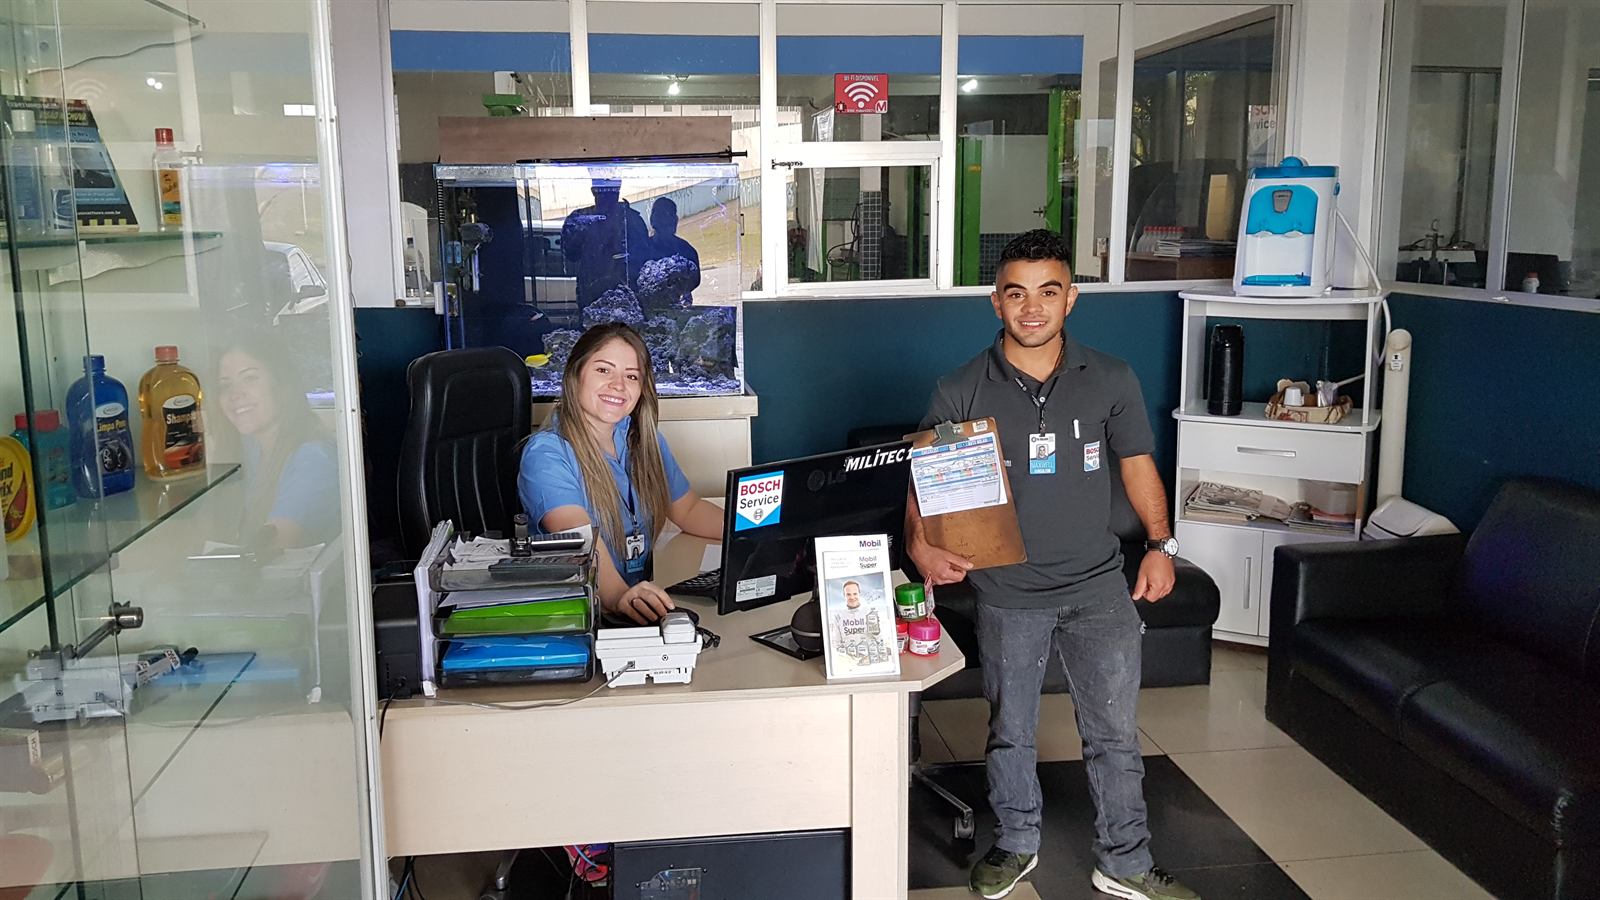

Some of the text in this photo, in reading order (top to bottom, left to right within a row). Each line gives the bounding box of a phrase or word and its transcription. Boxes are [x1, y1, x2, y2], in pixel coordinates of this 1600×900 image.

[741, 479, 780, 496] BOSCH
[740, 494, 779, 509] Service
[859, 540, 882, 548] Mobil
[842, 618, 865, 627] Mobil
[843, 626, 866, 636] Super
